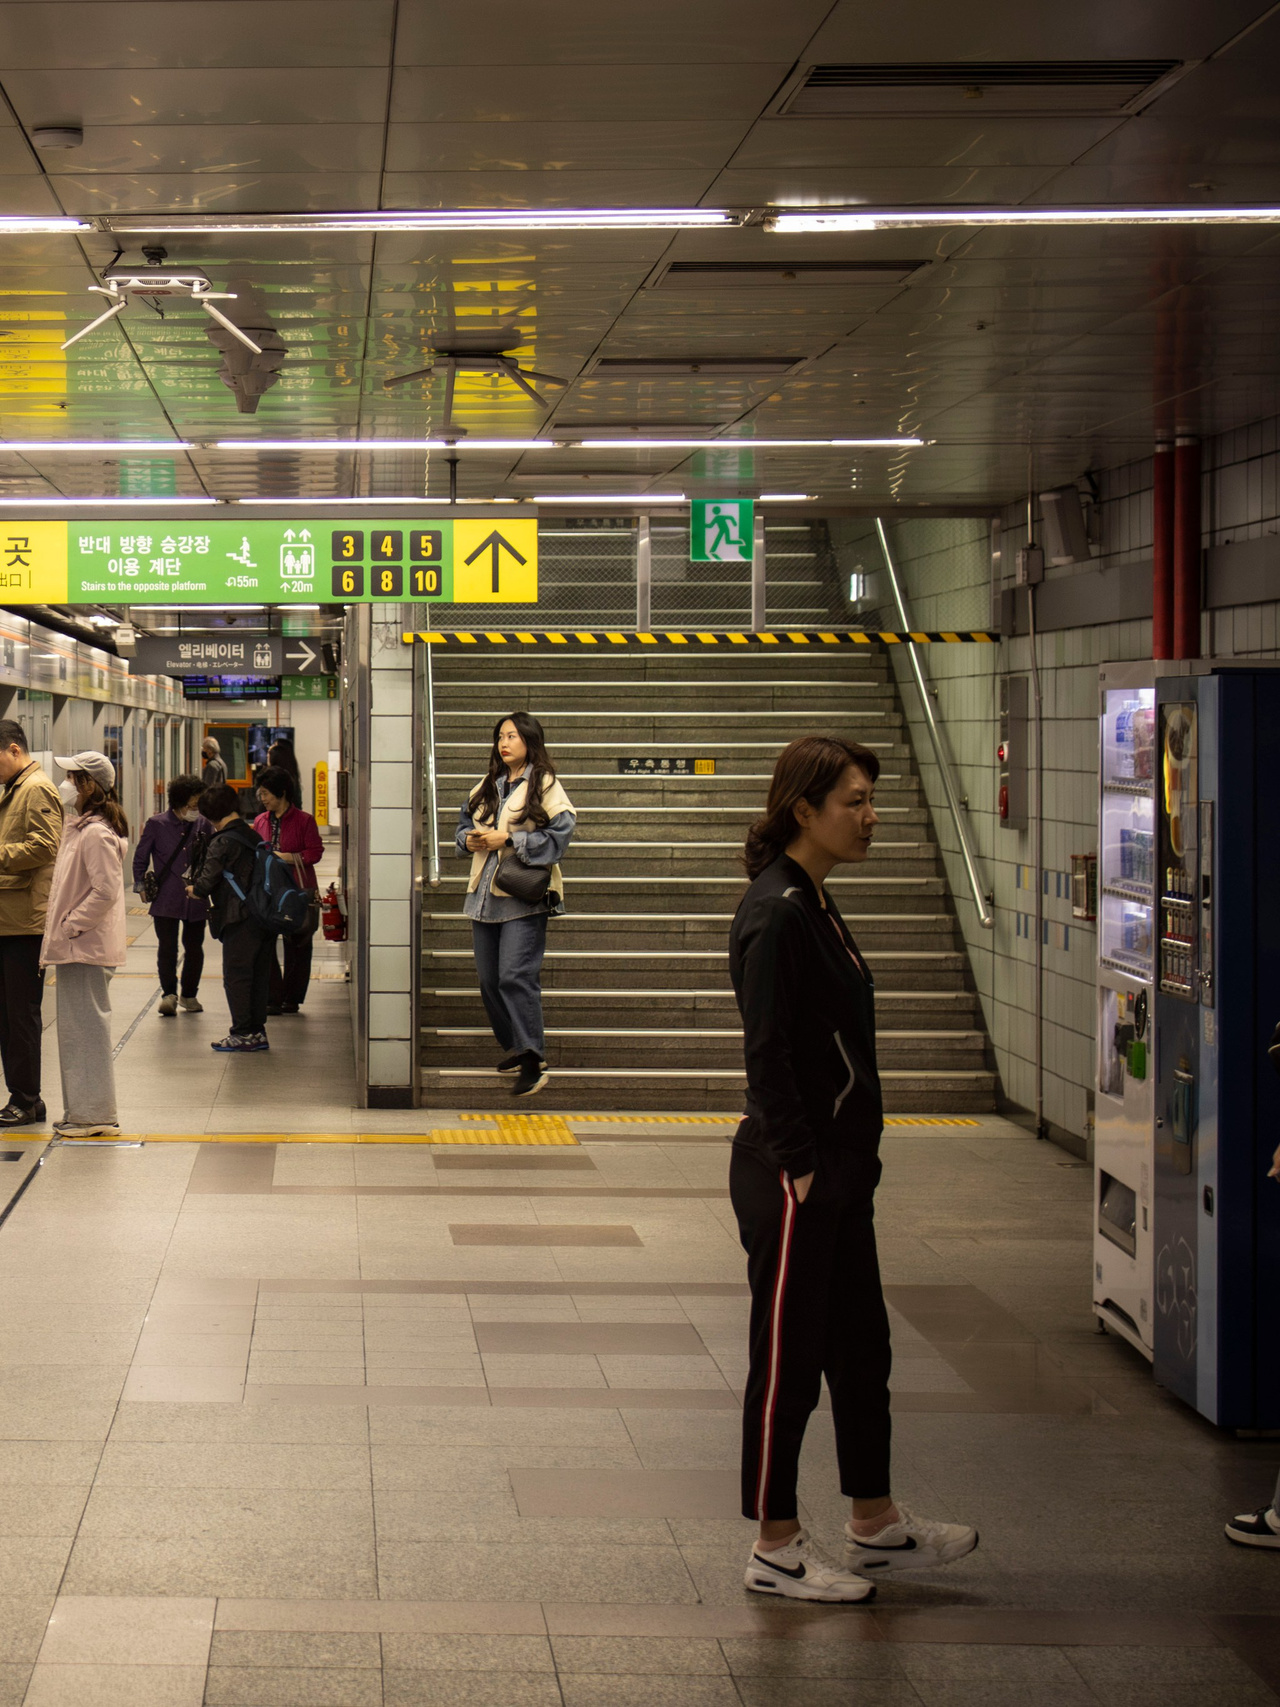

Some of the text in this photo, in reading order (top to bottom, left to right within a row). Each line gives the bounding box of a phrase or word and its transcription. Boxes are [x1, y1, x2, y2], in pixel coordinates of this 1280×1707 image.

[4, 536, 32, 567] 곳
[78, 536, 211, 554] 반대 방향 승강장
[342, 535, 433, 557] 3 4 5
[107, 558, 181, 576] 이용 계단
[81, 581, 207, 593] Stairs to the opposite platform
[236, 576, 258, 588] 55m
[291, 581, 313, 593] 20m
[342, 570, 437, 592] 6 8 10
[178, 643, 244, 659] 엘리베이터
[317, 770, 327, 819] 출입금지
